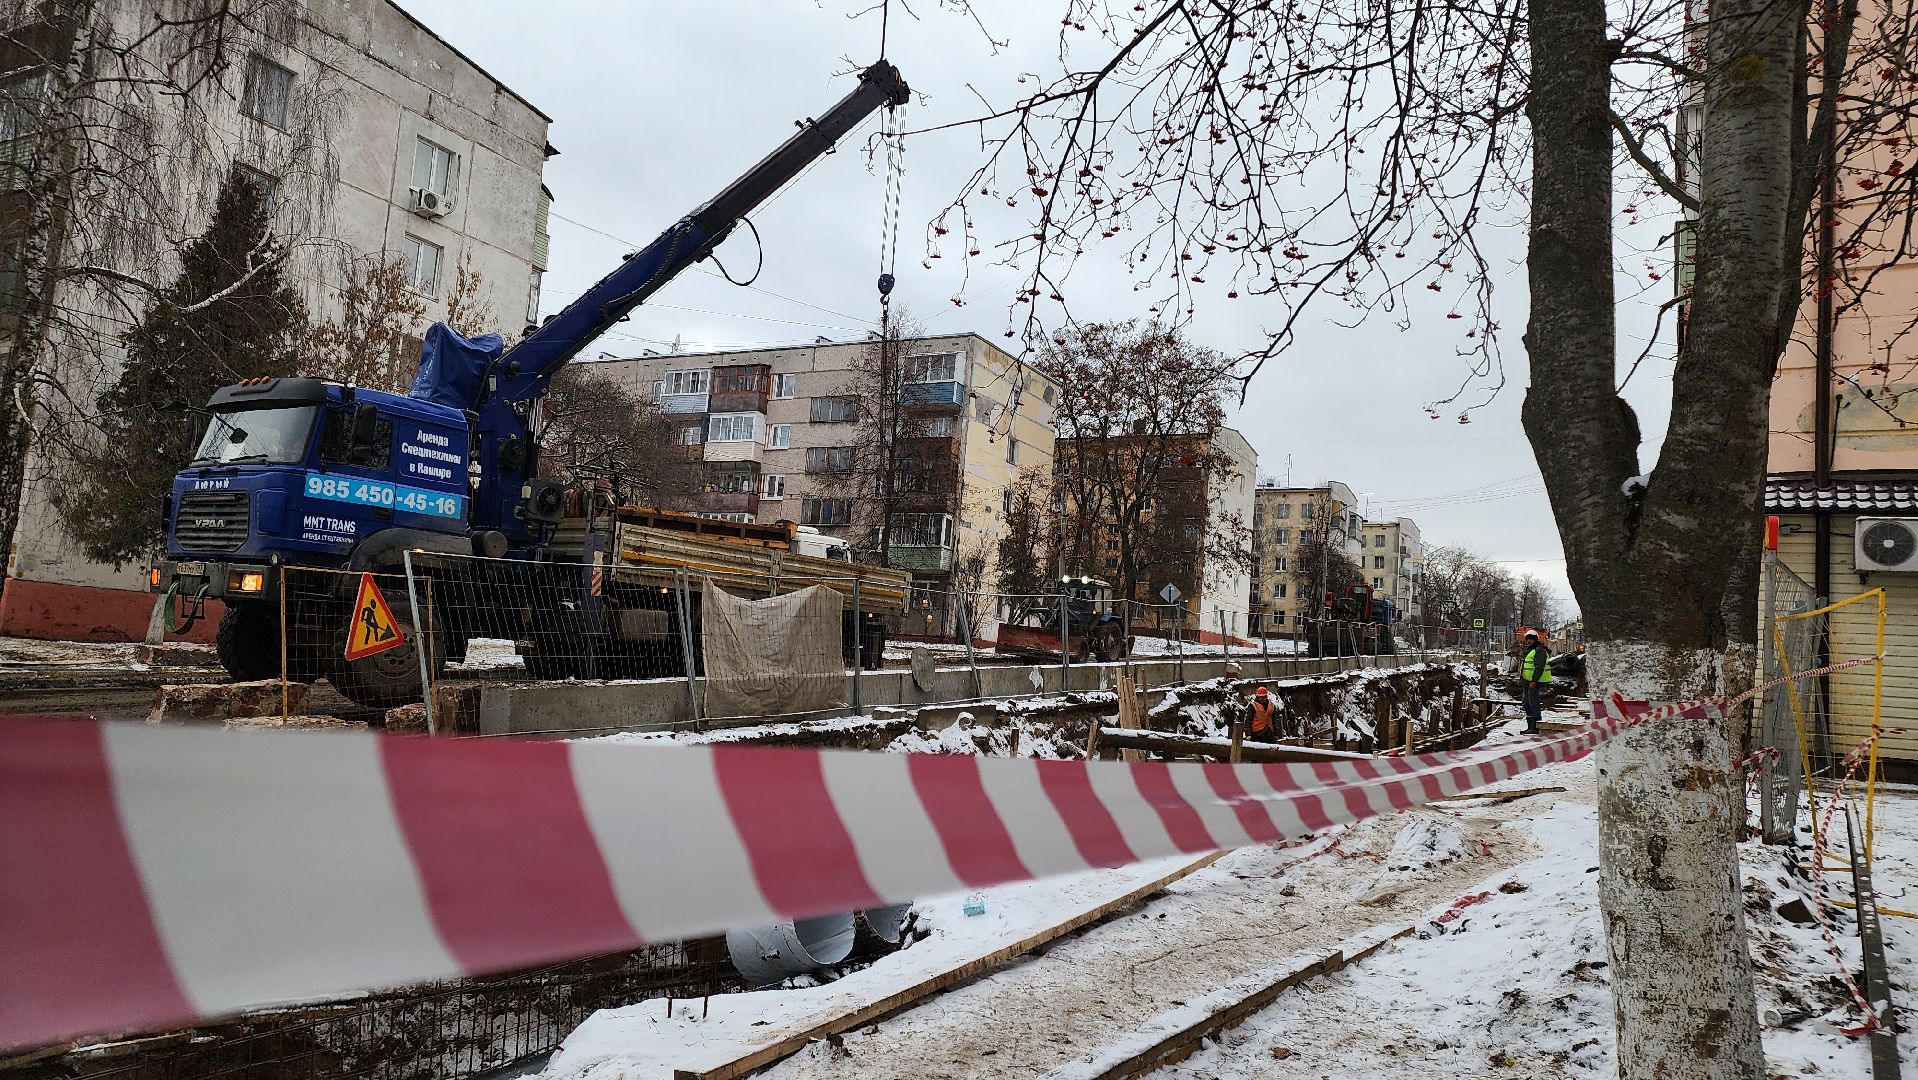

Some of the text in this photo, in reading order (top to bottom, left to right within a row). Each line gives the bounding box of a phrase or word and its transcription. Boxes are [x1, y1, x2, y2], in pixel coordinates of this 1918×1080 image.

[417, 430, 449, 447] Аренда
[401, 442, 461, 464] Спецтехники
[409, 462, 452, 479] в Кашире
[308, 477, 350, 498] 985
[195, 519, 226, 528] УРАЛ
[303, 515, 356, 533] MMT TRANS
